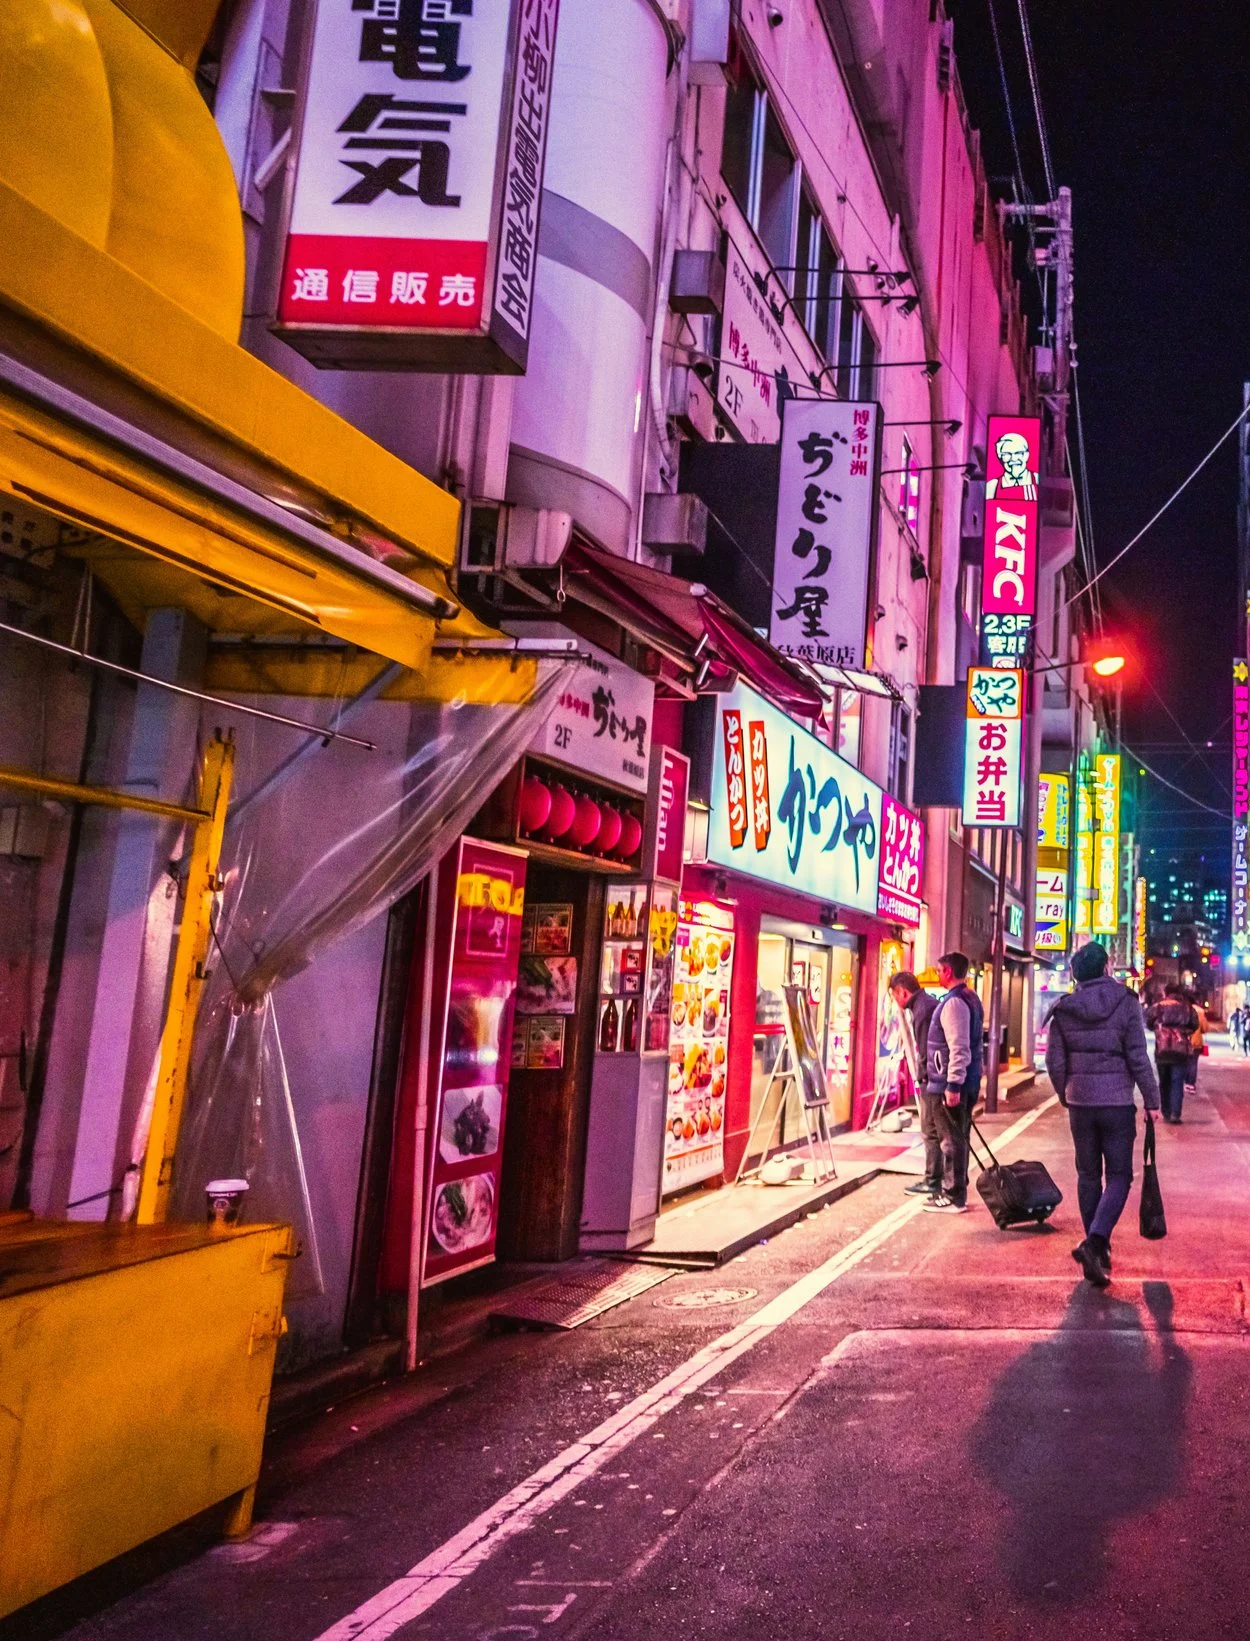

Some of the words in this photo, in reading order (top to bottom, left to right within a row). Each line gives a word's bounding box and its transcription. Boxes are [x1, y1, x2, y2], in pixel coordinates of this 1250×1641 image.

[332, 0, 474, 208] 電気
[291, 267, 477, 306] 通信販売
[724, 375, 743, 417] 2F
[849, 409, 870, 477] 博多中洲
[775, 431, 848, 640] ぢどり屋
[991, 506, 1026, 607] KFC
[974, 673, 1017, 713] かつや
[554, 724, 573, 749] 2F
[726, 715, 745, 831] とんかつ
[975, 722, 1008, 822] お弁当
[752, 729, 769, 833] カツ丼
[779, 735, 876, 895] かつや
[883, 845, 919, 894] とんかつ
[885, 801, 921, 862] カツ丼
